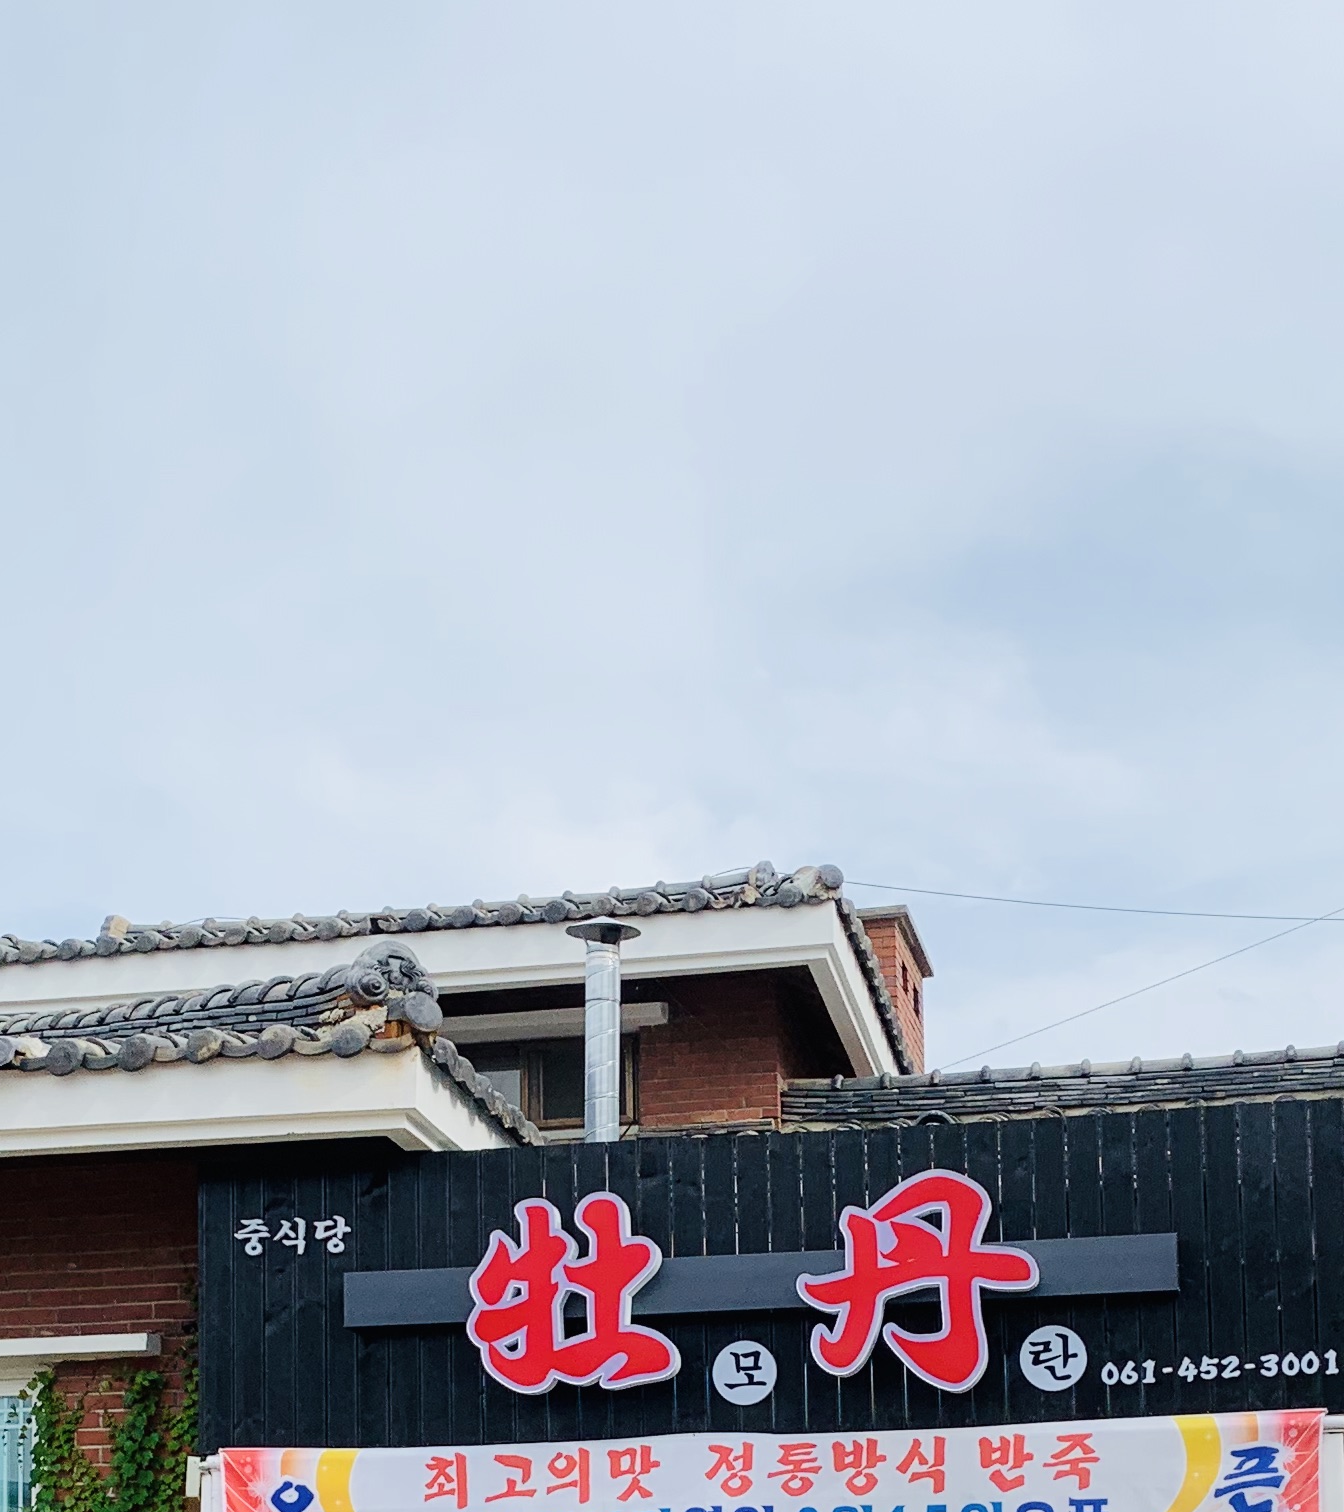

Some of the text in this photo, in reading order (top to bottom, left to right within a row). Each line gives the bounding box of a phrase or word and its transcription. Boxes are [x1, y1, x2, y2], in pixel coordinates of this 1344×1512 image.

[234, 1215, 352, 1256] 중식당
[723, 1350, 767, 1390] 모
[1028, 1332, 1078, 1380] 란
[1101, 1349, 1340, 1386] 061-452-3001
[423, 1432, 1101, 1509] 최고의맛 정통방식 반죽
